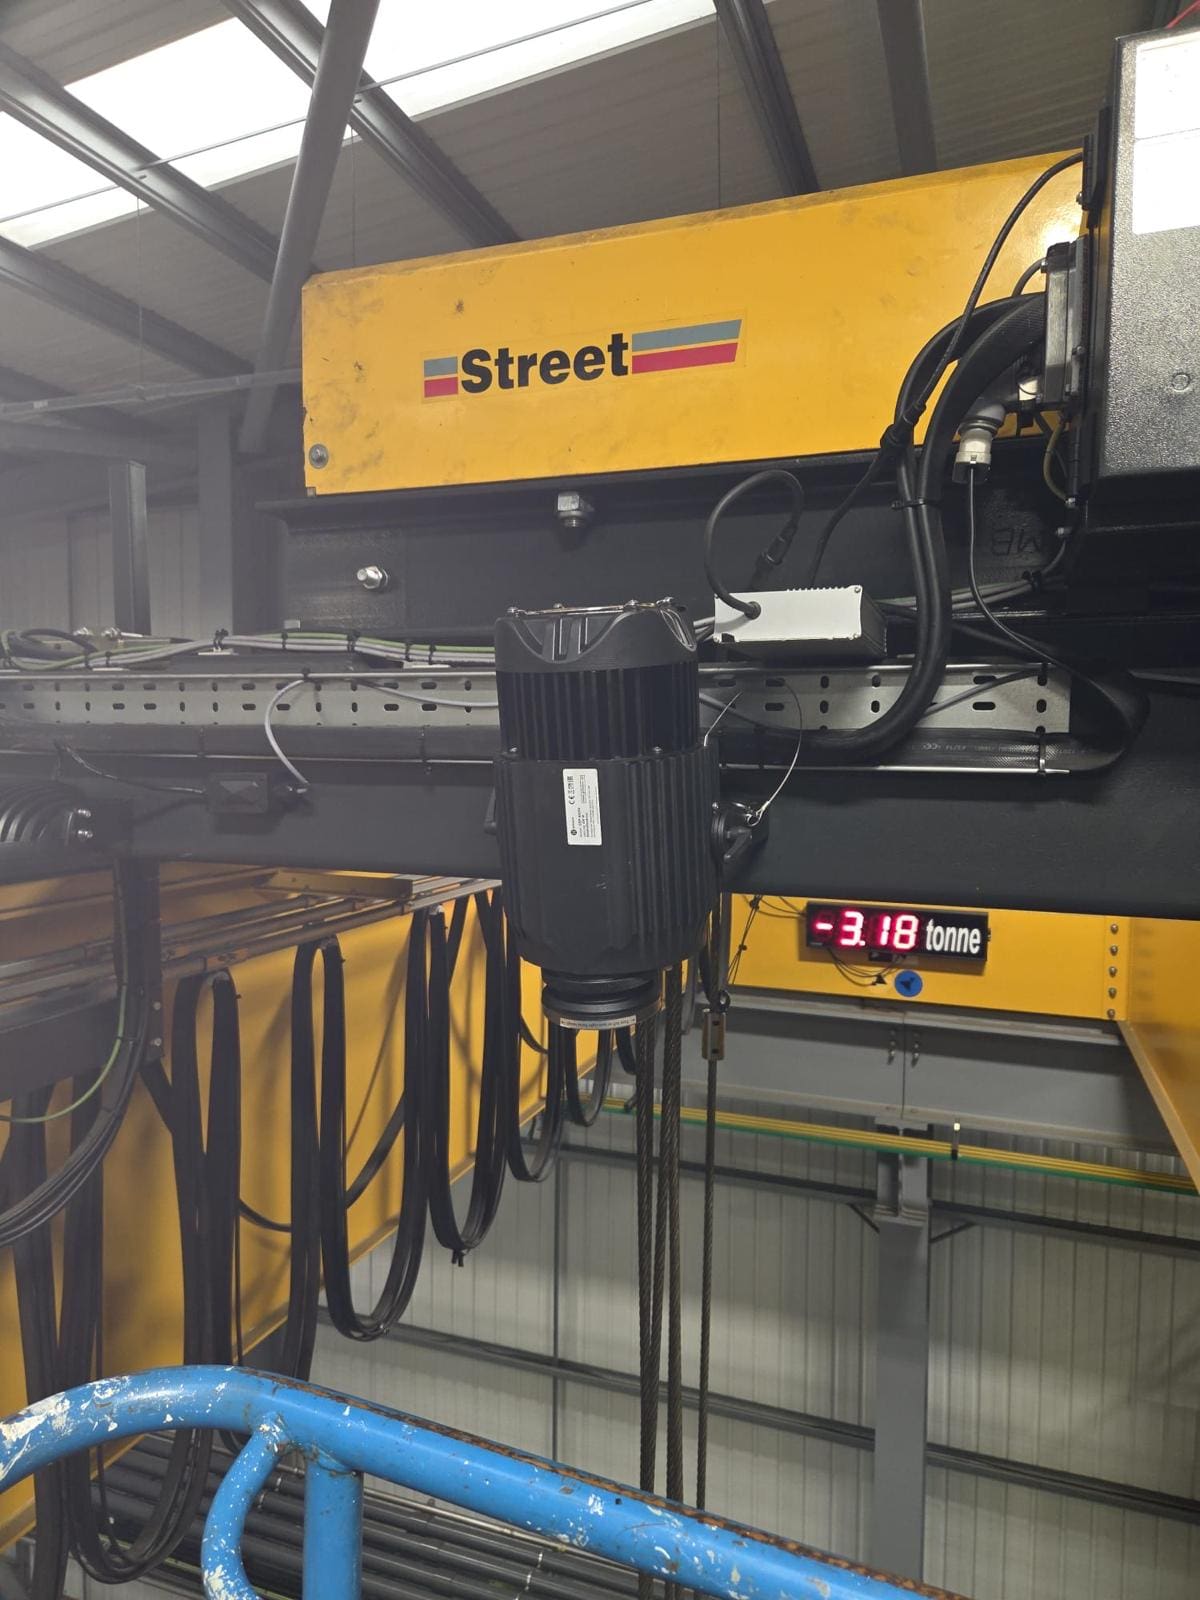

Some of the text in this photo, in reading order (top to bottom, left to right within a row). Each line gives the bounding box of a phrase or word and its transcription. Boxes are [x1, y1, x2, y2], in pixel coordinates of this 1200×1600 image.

[461, 332, 629, 394] Street
[815, 910, 981, 955] -3.18 tonne
